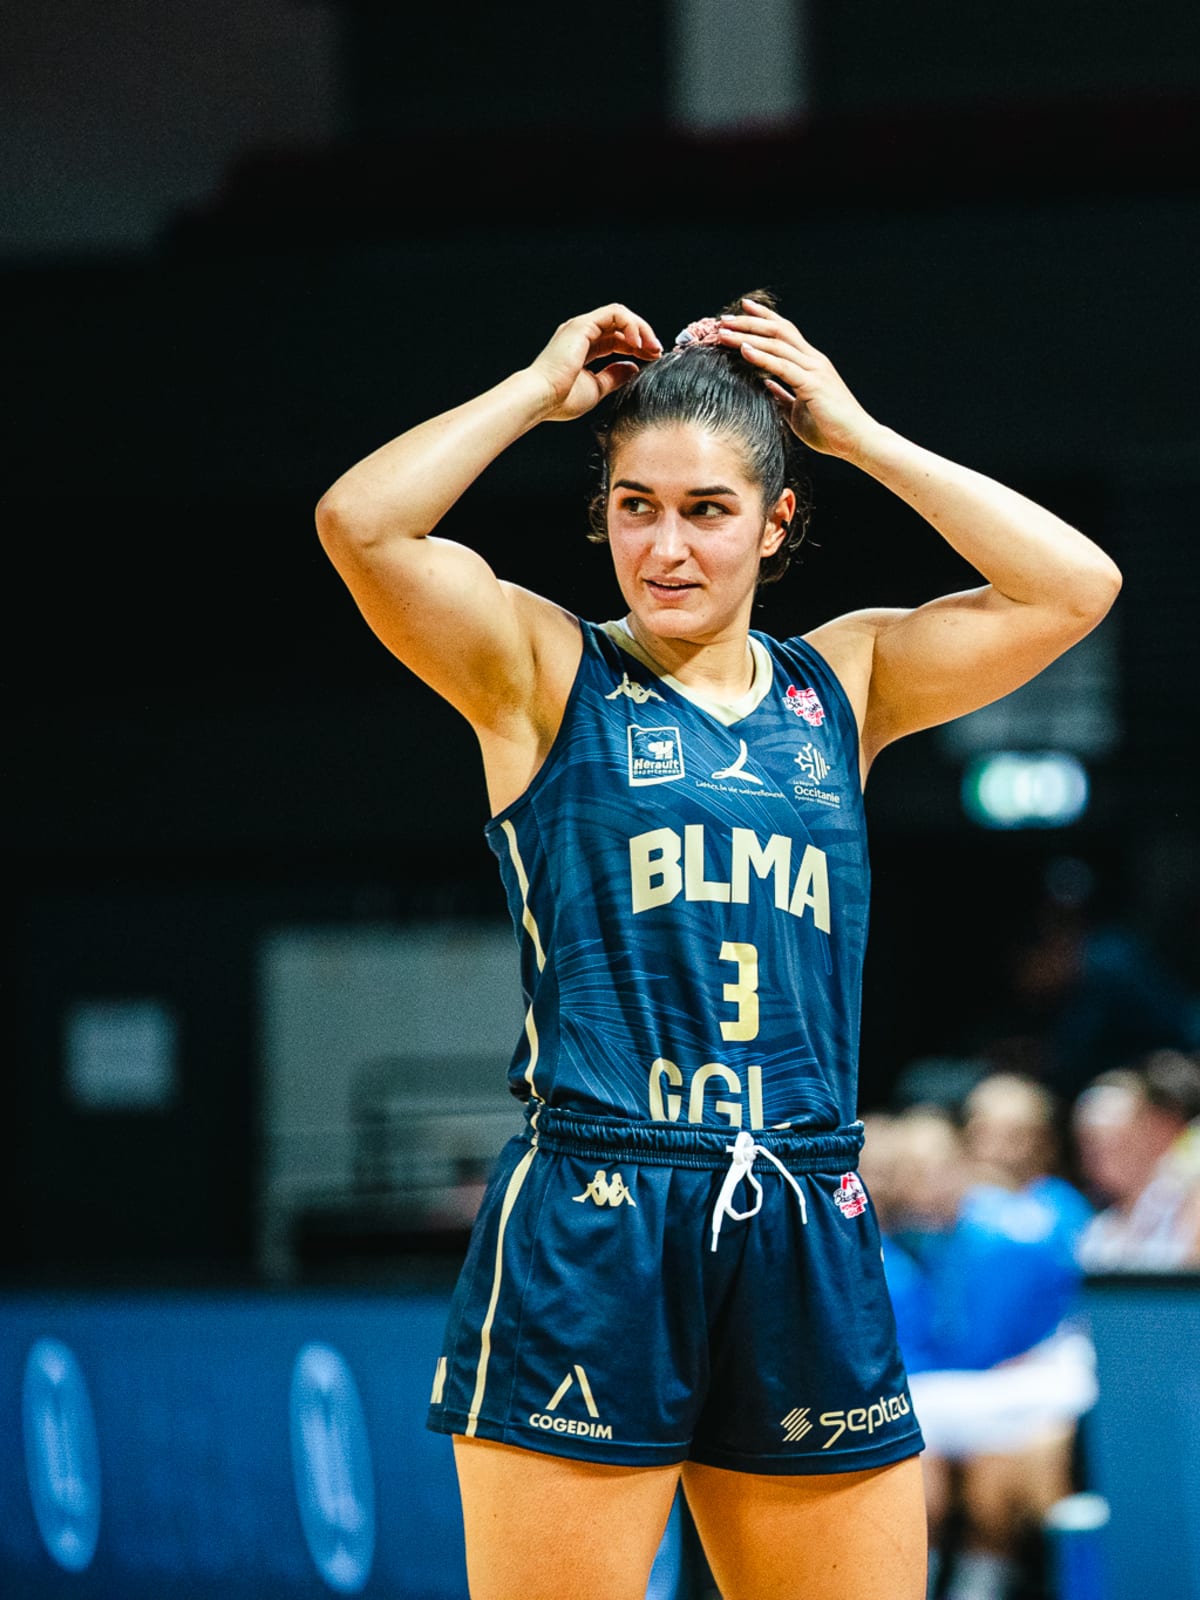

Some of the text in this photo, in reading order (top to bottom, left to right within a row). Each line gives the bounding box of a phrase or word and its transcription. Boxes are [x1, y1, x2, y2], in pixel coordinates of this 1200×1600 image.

[793, 785, 841, 804] Occitanie
[629, 824, 831, 935] BLMA
[718, 940, 760, 1042] 3
[528, 1413, 613, 1441] COGEDIM
